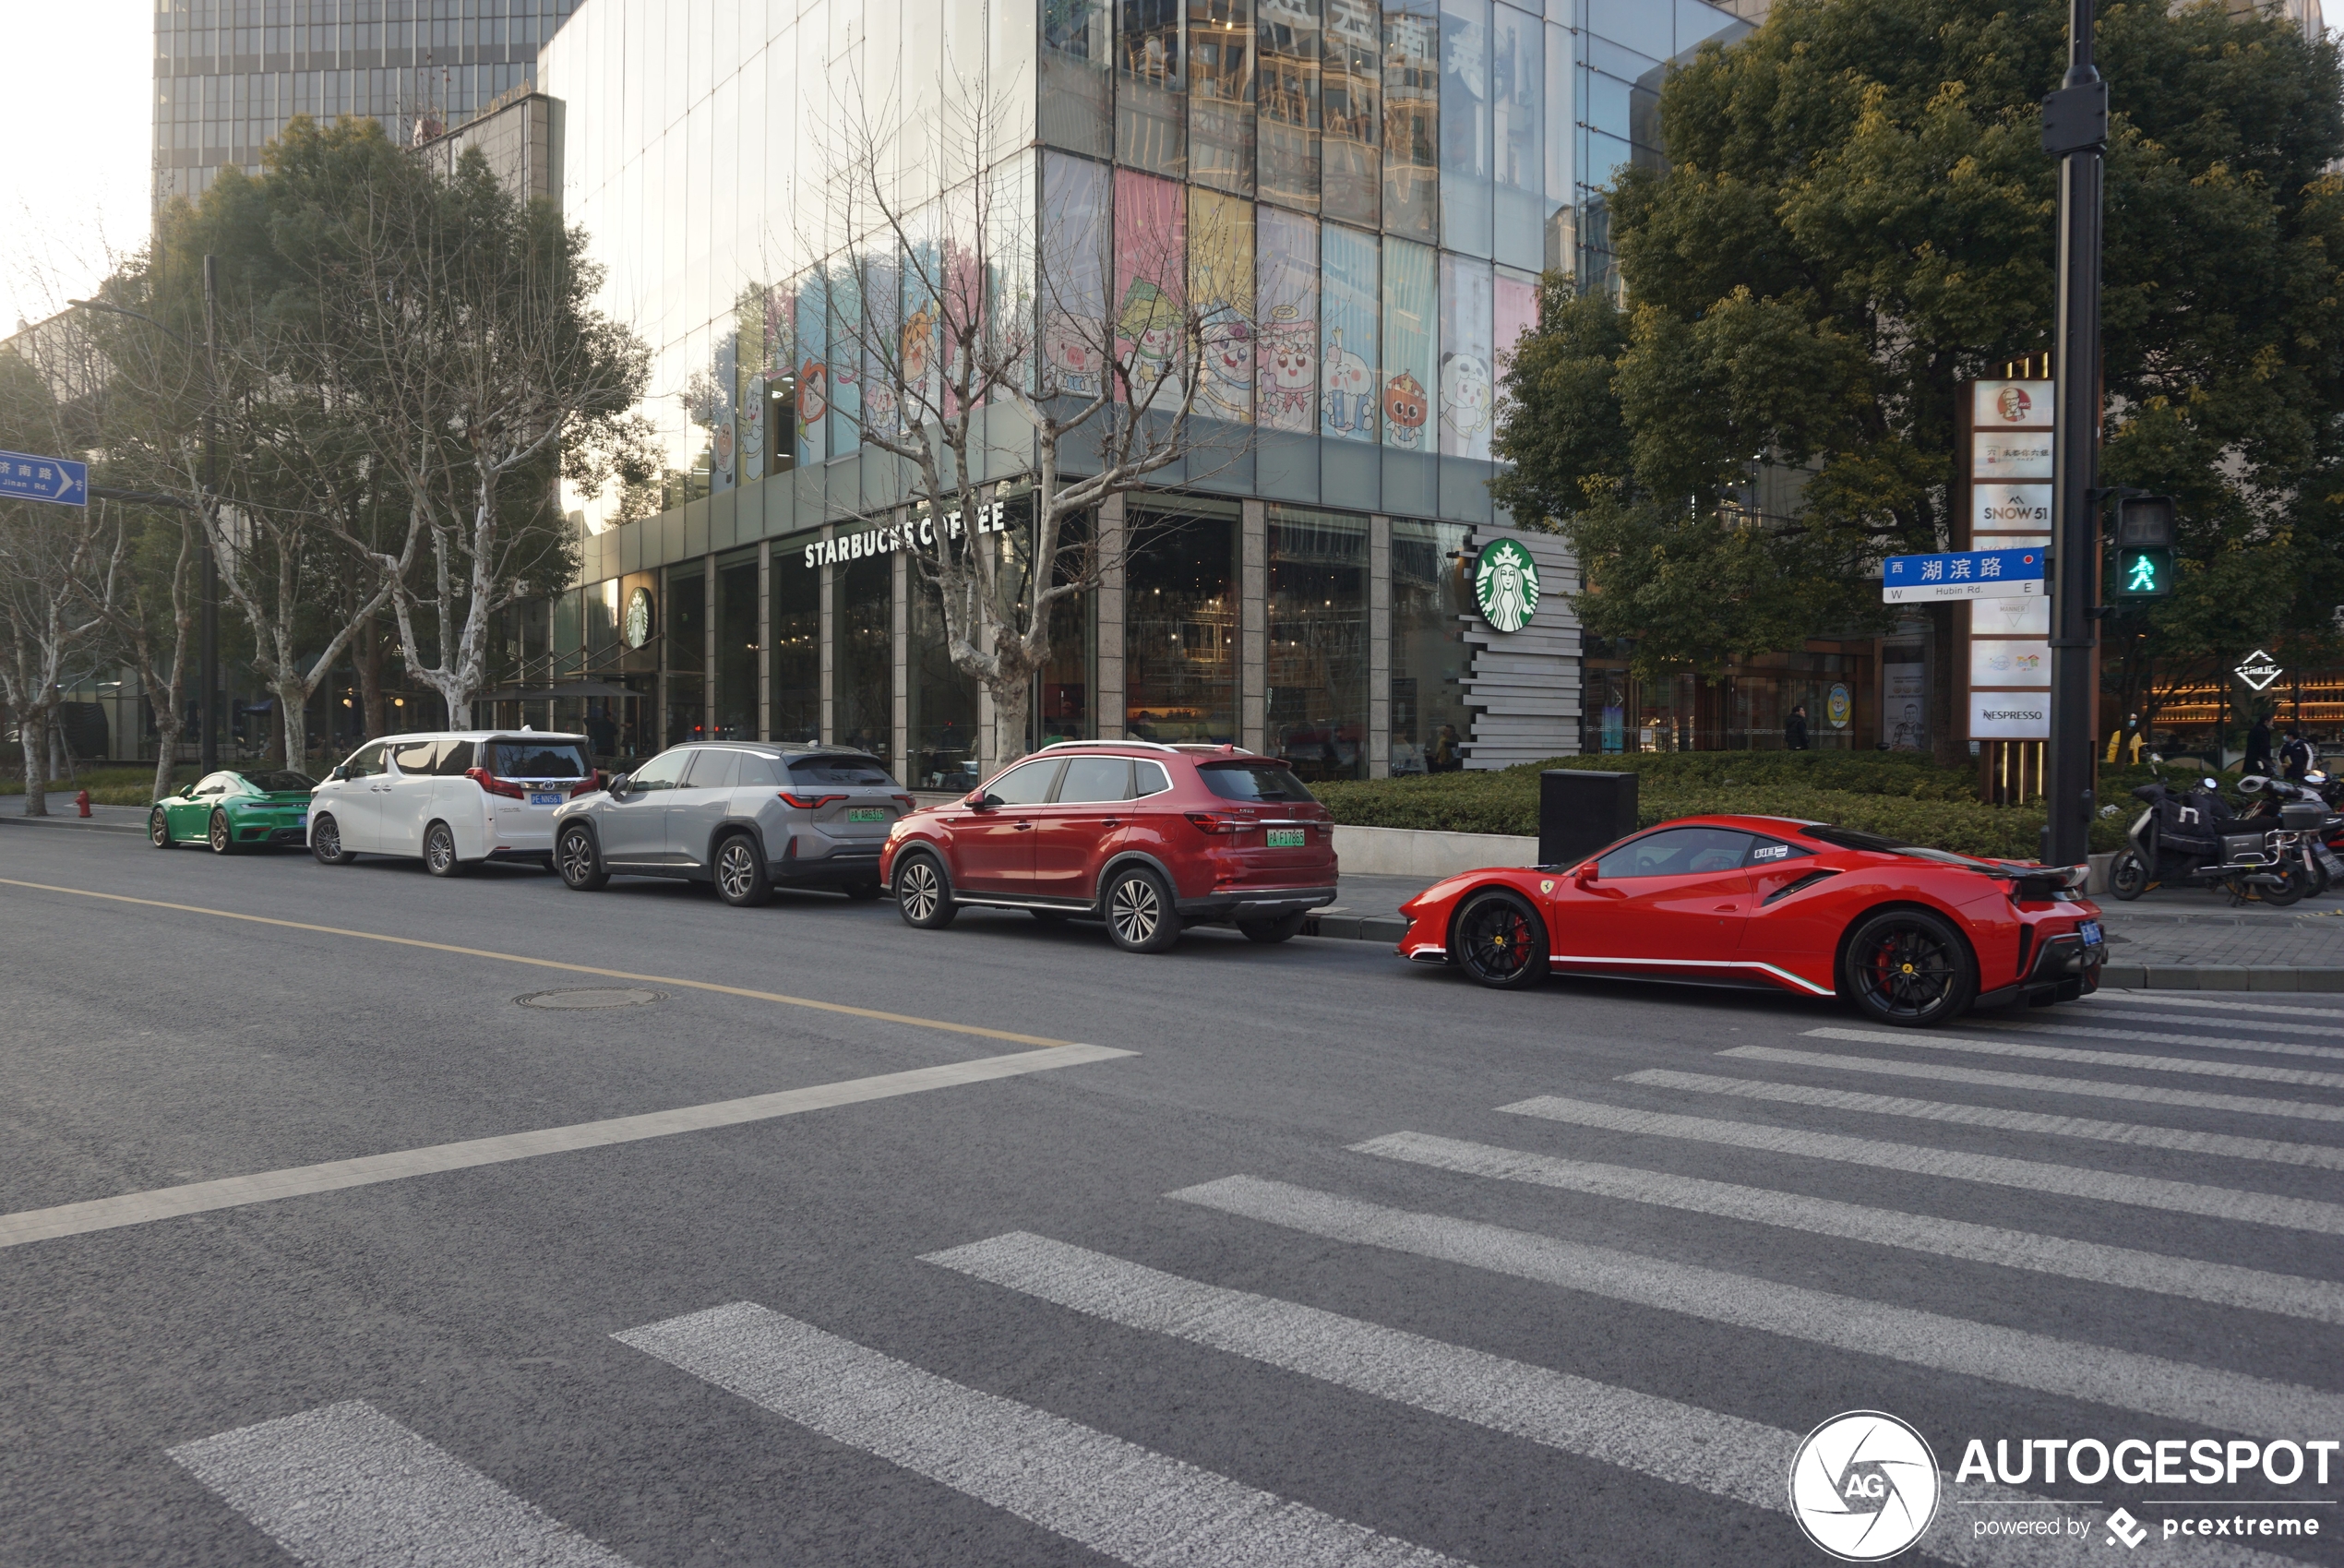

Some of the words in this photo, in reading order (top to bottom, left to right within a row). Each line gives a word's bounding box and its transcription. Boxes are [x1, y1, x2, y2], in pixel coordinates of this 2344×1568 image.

[2, 479, 27, 487] Jinan
[34, 483, 49, 491] Rd.
[75, 479, 83, 487] 北
[1984, 507, 2032, 520] SNOW
[2034, 507, 2047, 520] 51
[805, 521, 914, 569] STARBUCKS
[1892, 561, 1904, 574] 西
[1920, 557, 2002, 581] 湖滨路
[1891, 590, 1902, 599] W
[1936, 587, 1962, 595] Hubin
[1967, 585, 1983, 594] Rd.
[2025, 583, 2032, 592] E
[1981, 709, 2042, 721] NESPRESSO
